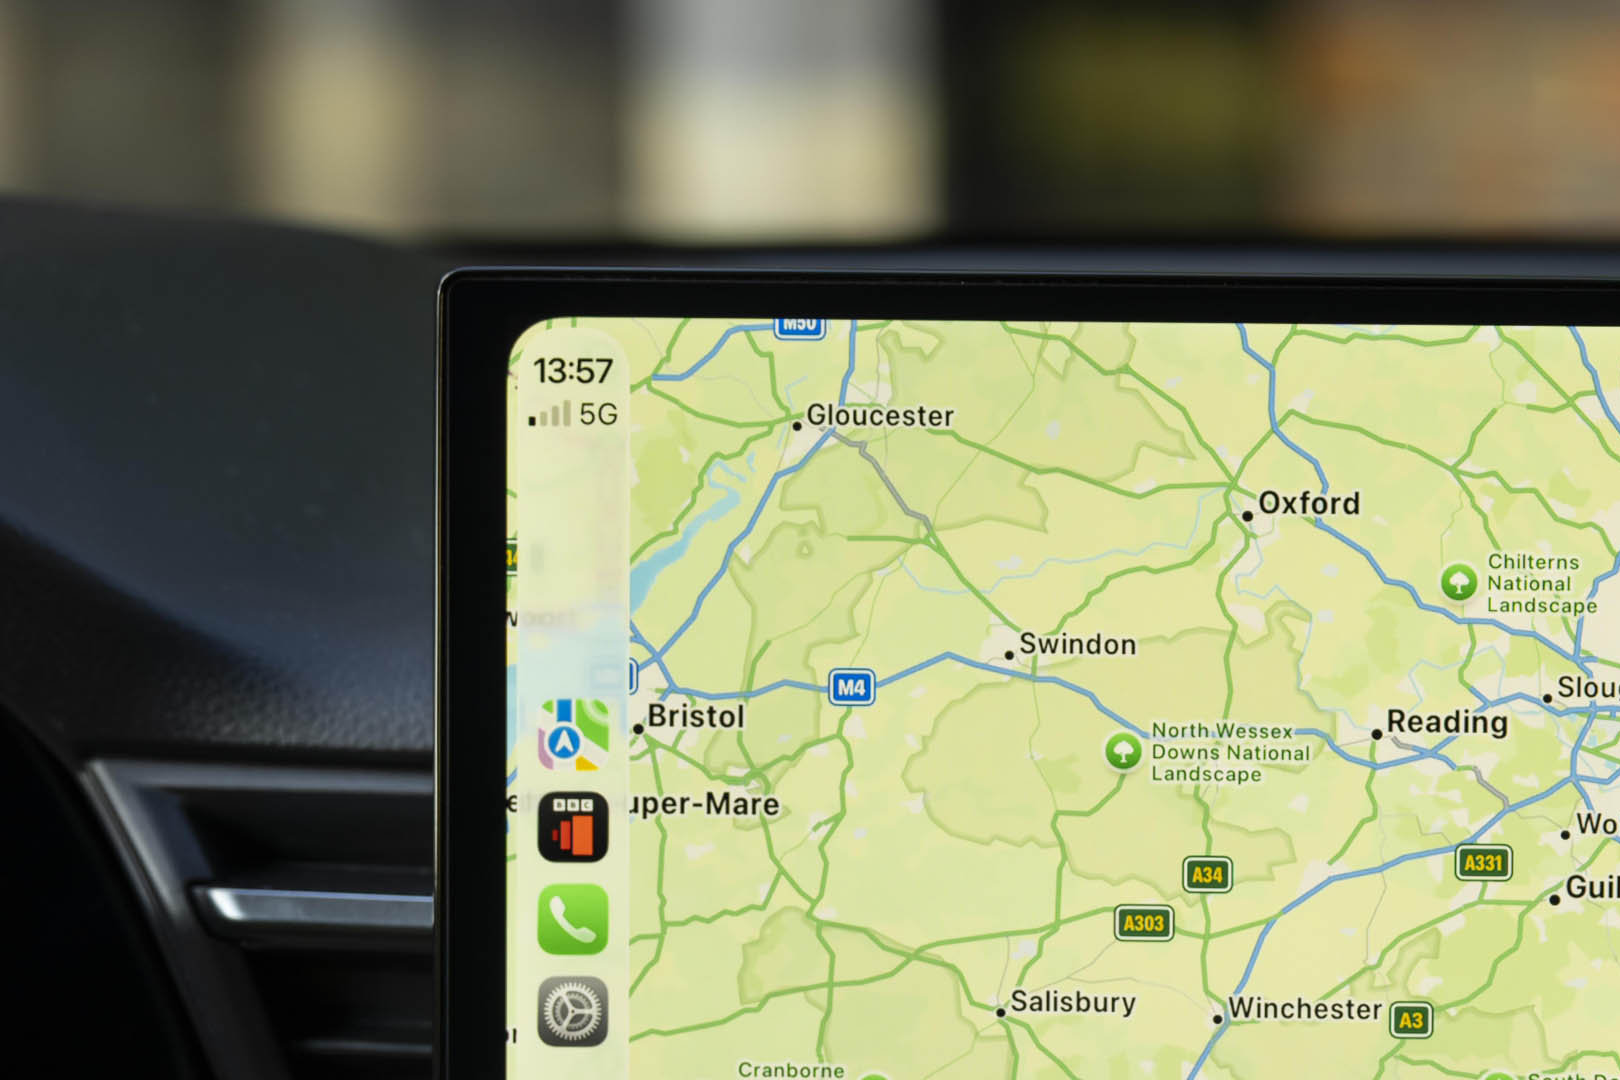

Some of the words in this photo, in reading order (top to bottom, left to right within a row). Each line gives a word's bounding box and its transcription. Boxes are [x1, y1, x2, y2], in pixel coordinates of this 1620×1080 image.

[783, 319, 817, 331] M50
[534, 357, 614, 384] 13:57
[580, 402, 618, 426] 5G
[807, 403, 954, 427] Gloucester
[1259, 490, 1360, 515] Oxford
[1488, 553, 1579, 570] Chilterns
[1488, 575, 1571, 592] National
[1488, 597, 1597, 617] Landscape
[1020, 632, 1136, 655] Swindon
[838, 678, 865, 697] M4
[648, 703, 744, 728] Bristol
[1388, 709, 1508, 739] Reading
[1152, 722, 1209, 738] North
[1216, 722, 1292, 739] Wessex
[1152, 743, 1220, 761] Downs
[1227, 744, 1310, 761] National
[1152, 765, 1261, 785] Landscape
[554, 798, 593, 811] BBC
[1465, 854, 1502, 872] A331
[1193, 866, 1223, 884] A34
[1124, 914, 1164, 933] A303
[1011, 989, 1136, 1018] Salisbury
[1228, 996, 1383, 1020] Winchester
[1399, 1011, 1423, 1029] A3
[738, 1062, 845, 1079] Cranborne
